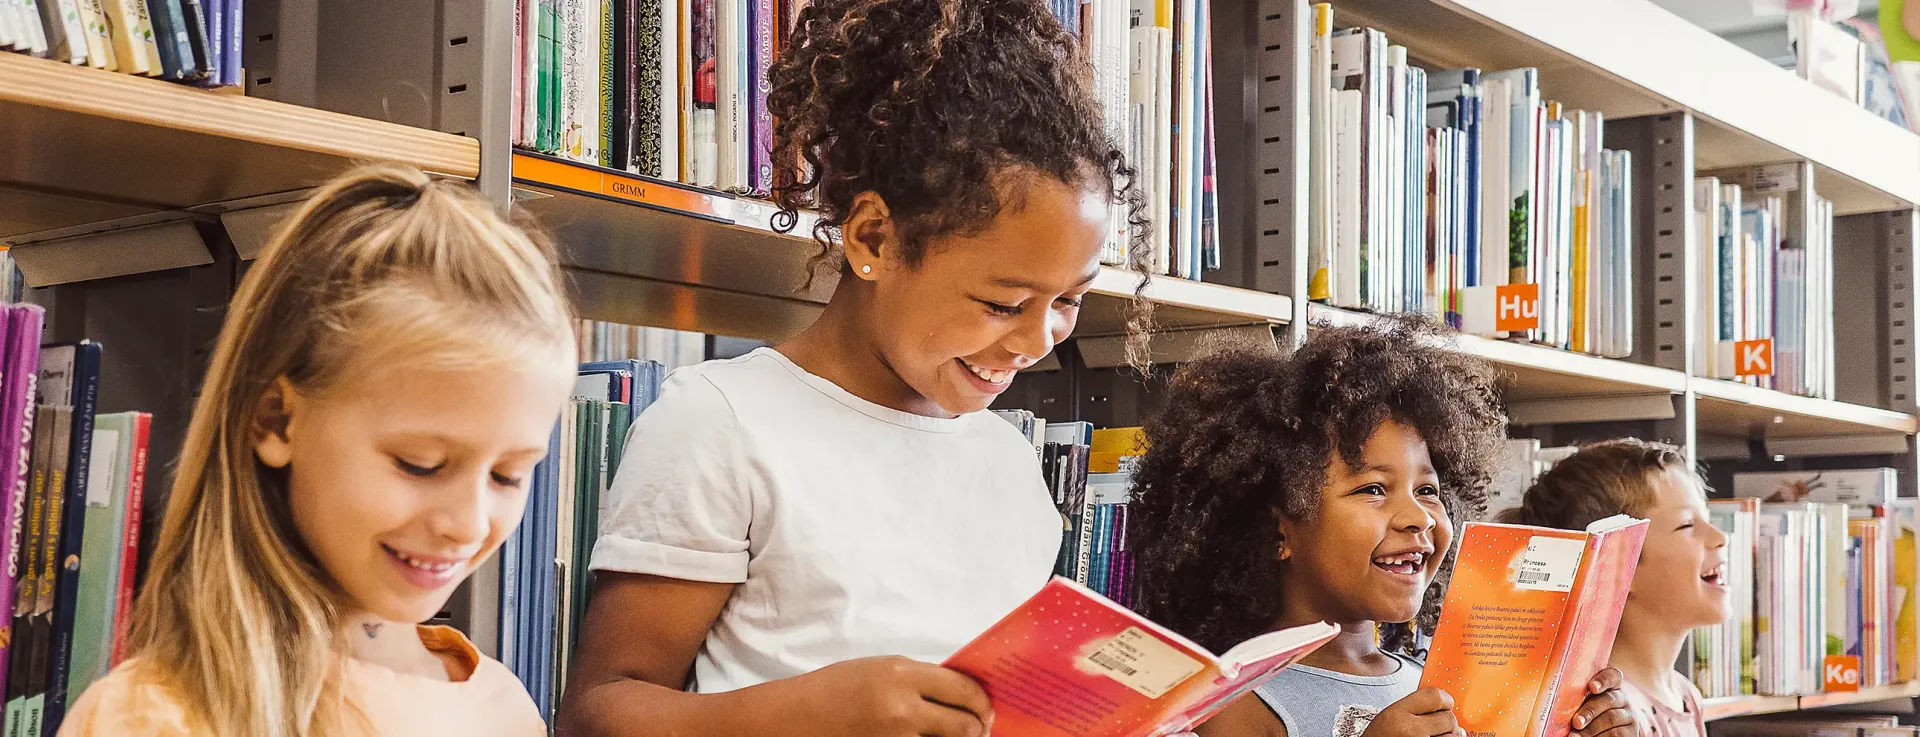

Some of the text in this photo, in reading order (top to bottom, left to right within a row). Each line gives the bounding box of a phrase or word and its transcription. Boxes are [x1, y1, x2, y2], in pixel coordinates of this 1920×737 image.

[601, 12, 609, 47] Grimm
[601, 53, 609, 97] Wilhelm
[601, 108, 609, 139] Jacob
[612, 182, 646, 198] GRIMM
[1500, 295, 1538, 319] Hu
[1743, 343, 1768, 371] K
[18, 446, 29, 476] ZA
[1083, 503, 1095, 547] Bogdan
[1826, 664, 1858, 685] Ke
